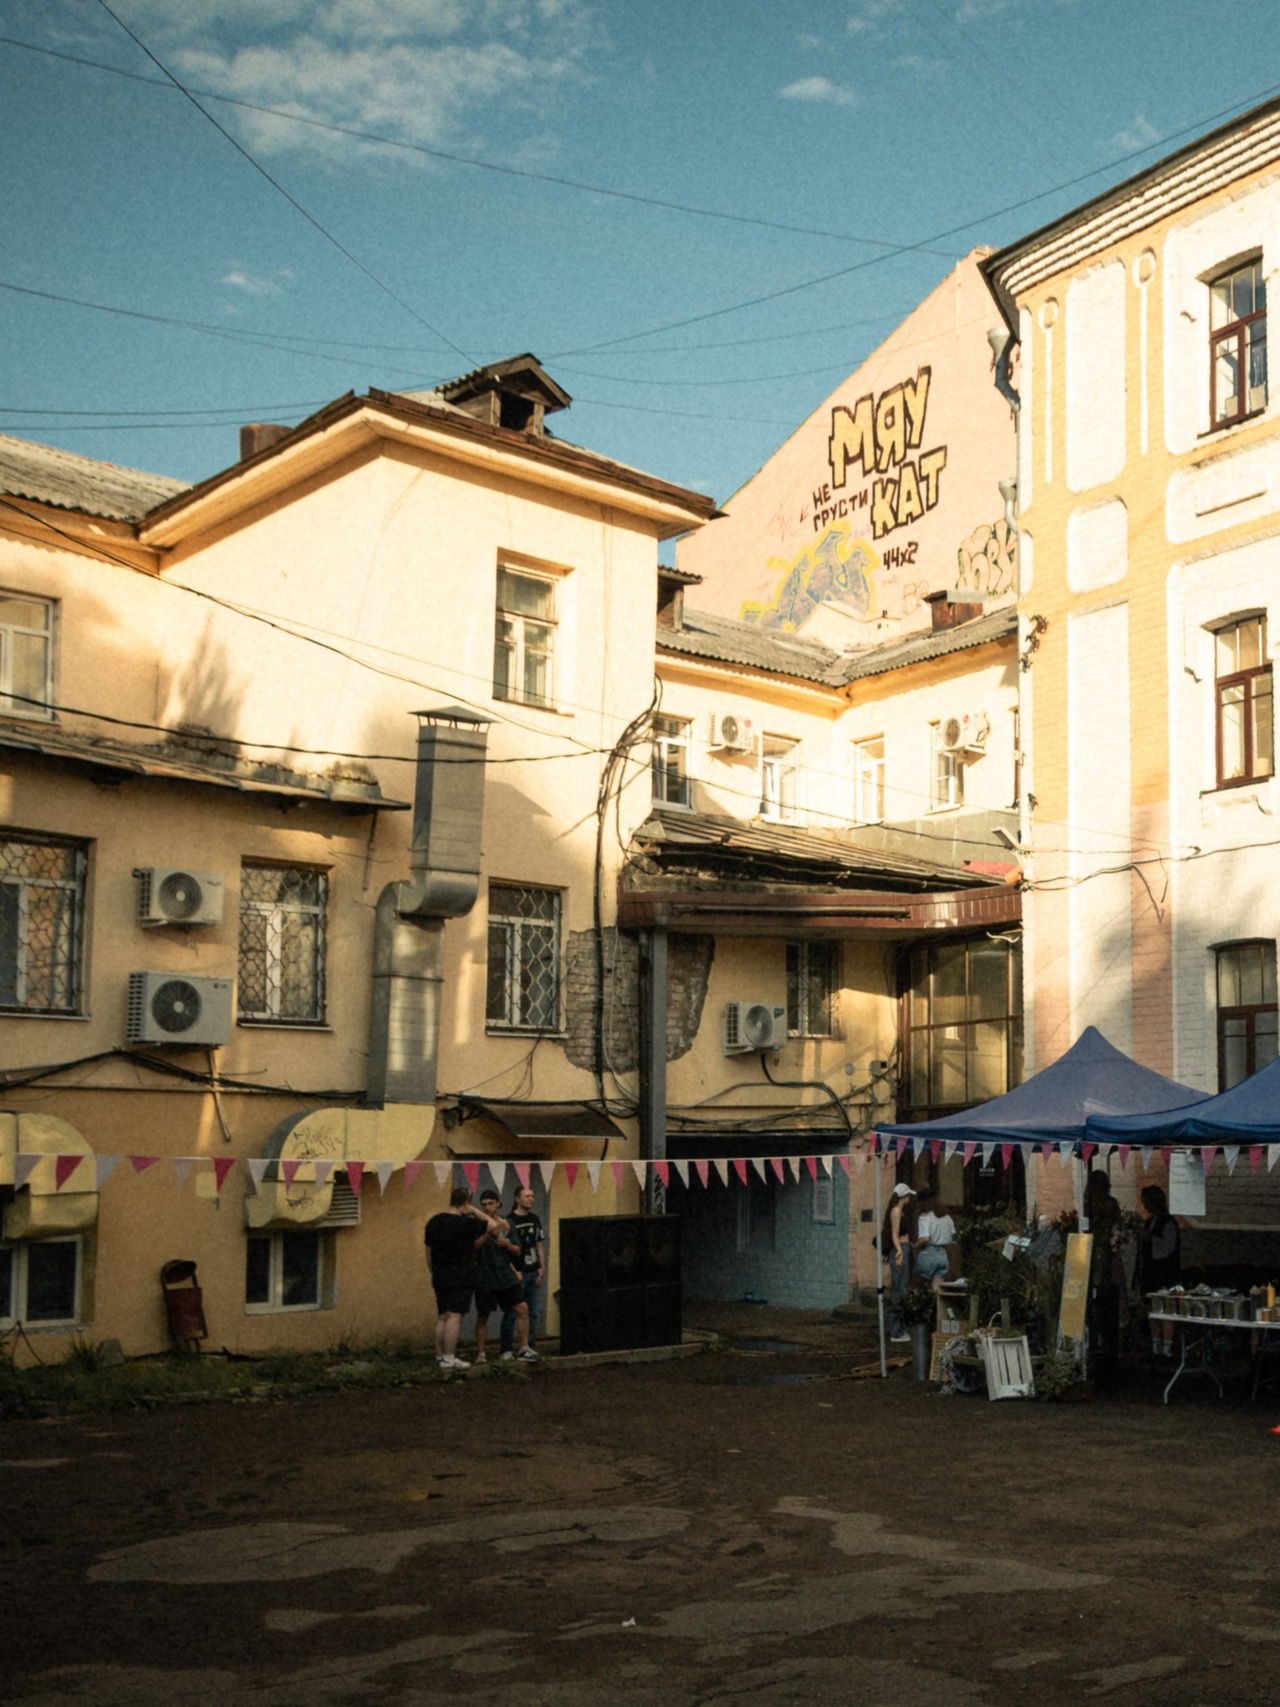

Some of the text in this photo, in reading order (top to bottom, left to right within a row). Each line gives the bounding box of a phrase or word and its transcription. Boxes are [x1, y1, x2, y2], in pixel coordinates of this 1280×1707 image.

[828, 365, 931, 490] МЯУ
[812, 483, 832, 510] НЕ
[813, 489, 869, 532] ГРУСТИ
[871, 444, 947, 541] КАТ
